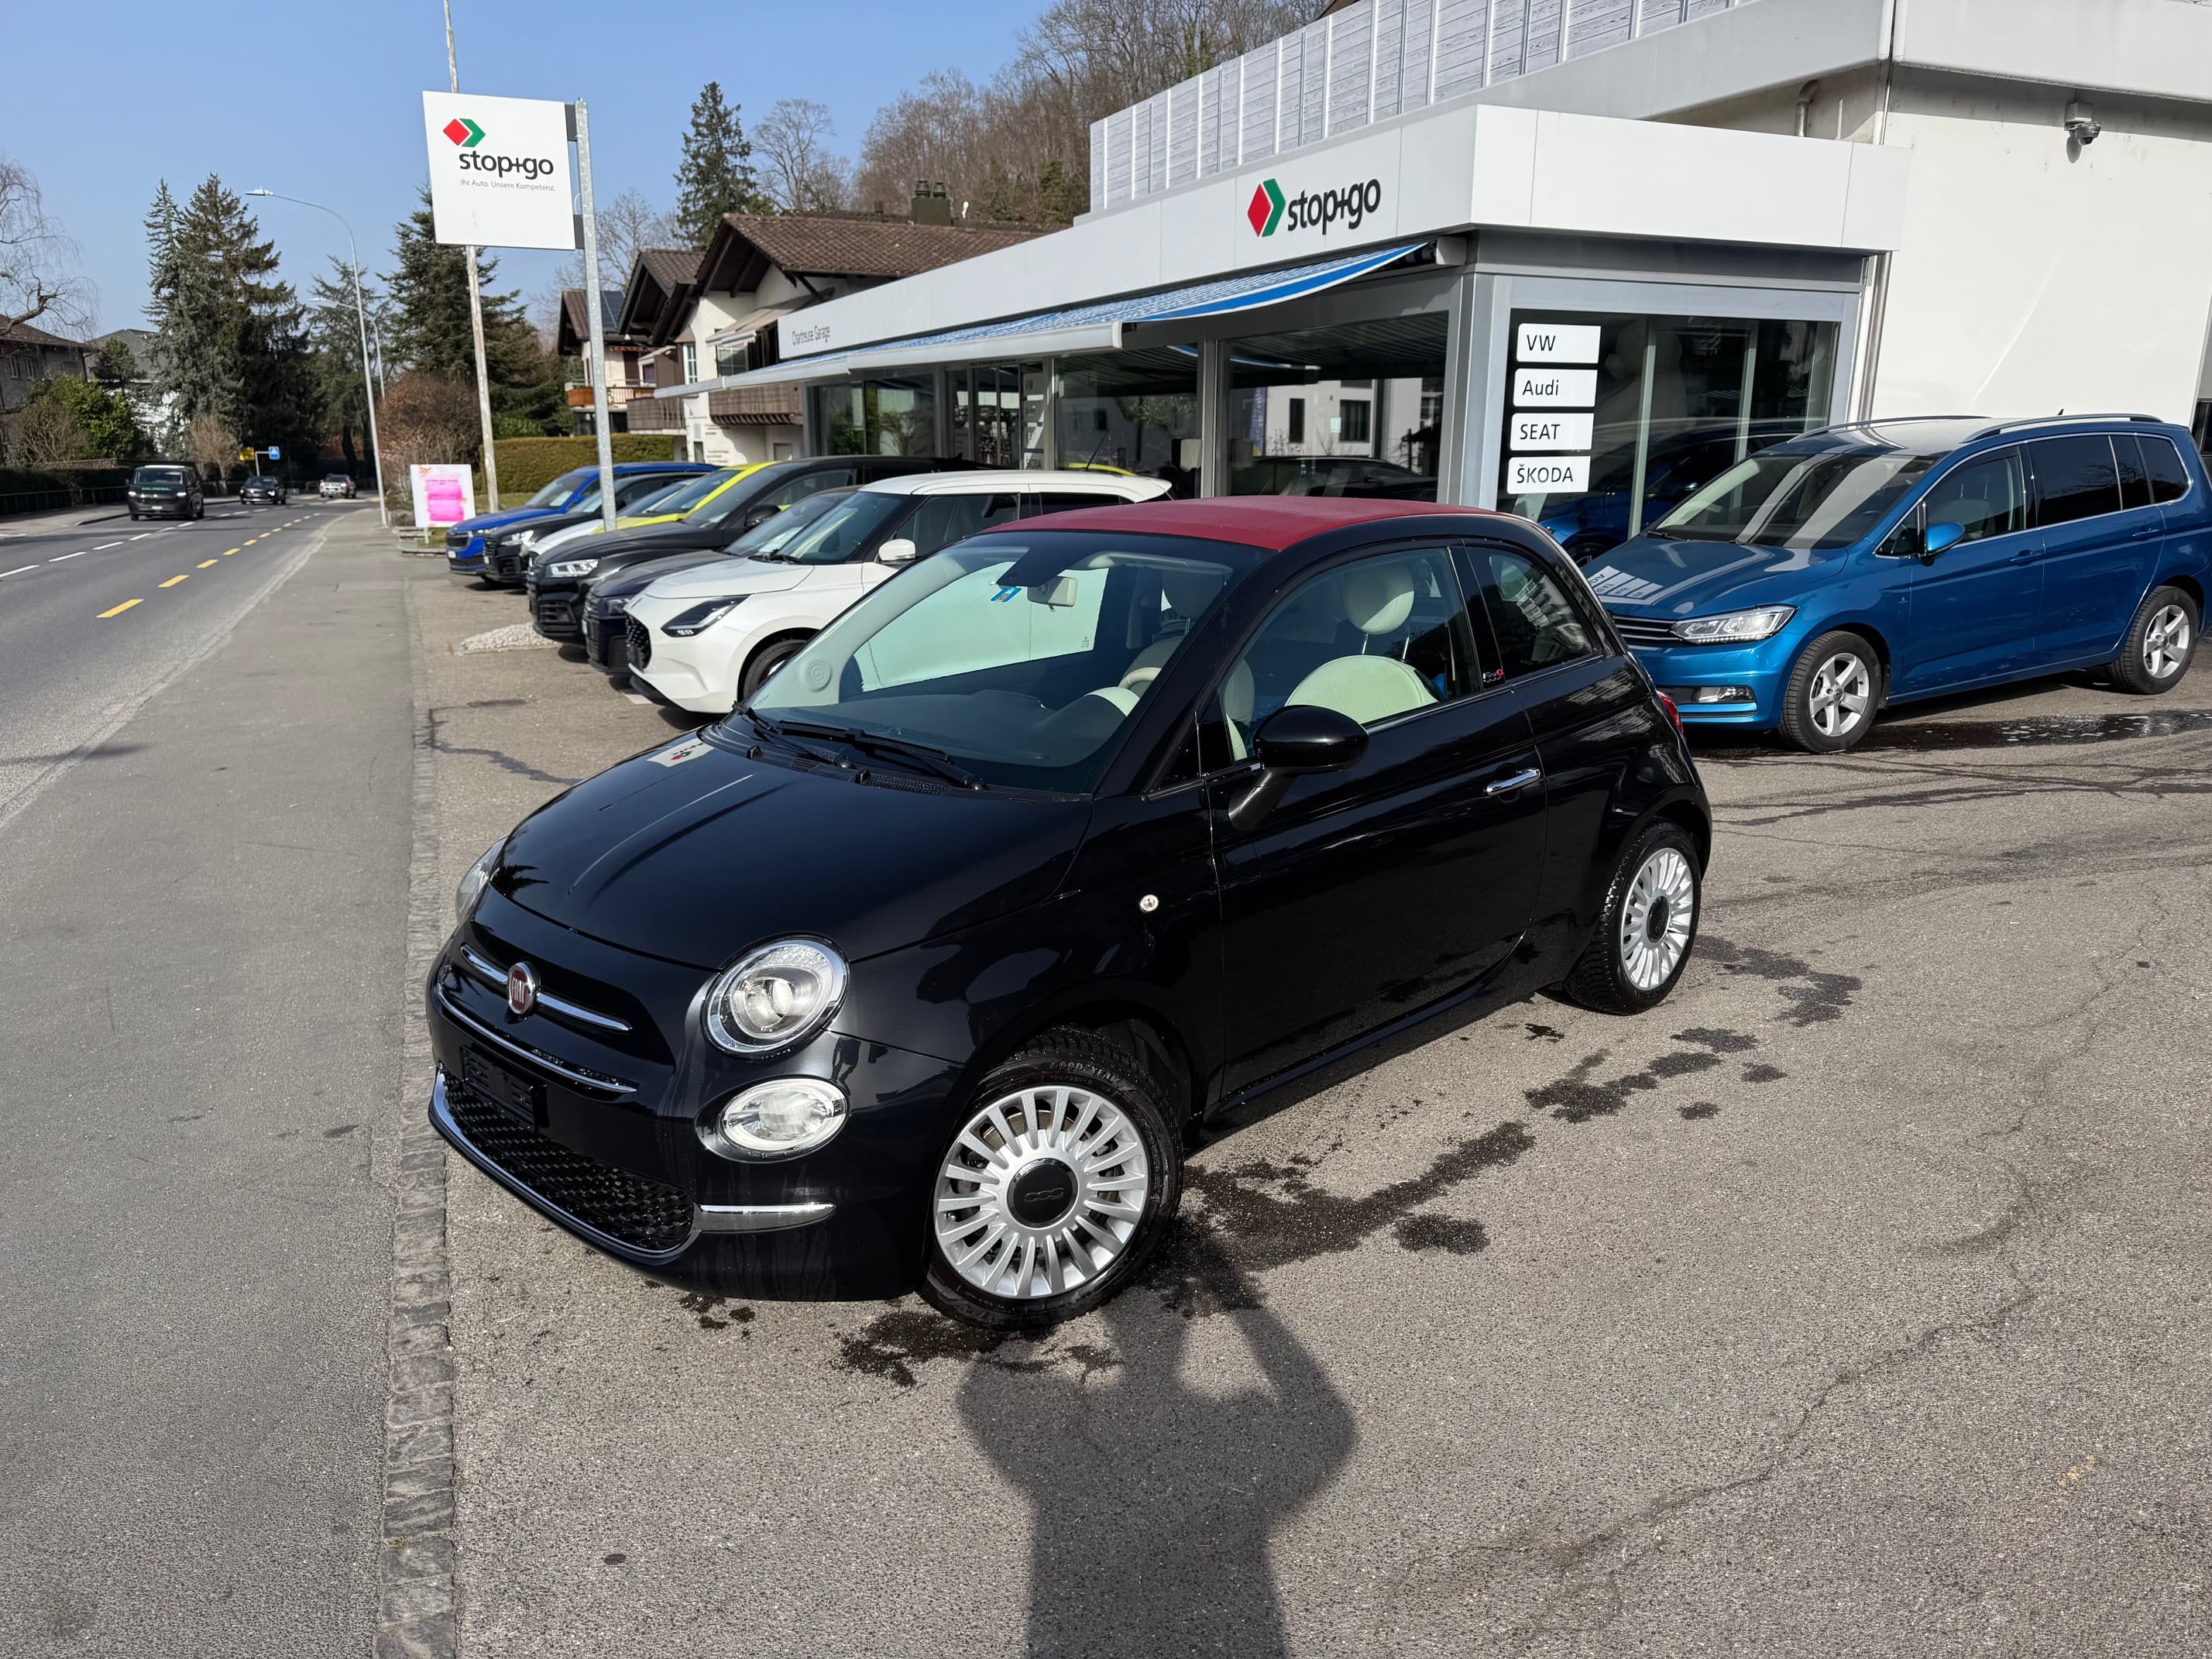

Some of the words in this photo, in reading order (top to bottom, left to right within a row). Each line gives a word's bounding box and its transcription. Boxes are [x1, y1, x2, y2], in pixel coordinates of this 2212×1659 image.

[459, 150, 554, 180] stop+go
[1287, 178, 1382, 235] stop+go
[814, 325, 831, 343] Garage
[1526, 335, 1556, 352] VW
[1522, 379, 1560, 396] Audi
[1520, 424, 1561, 440] SEAT
[1516, 463, 1574, 484] ŠKODA
[511, 977, 527, 1004] FIAT
